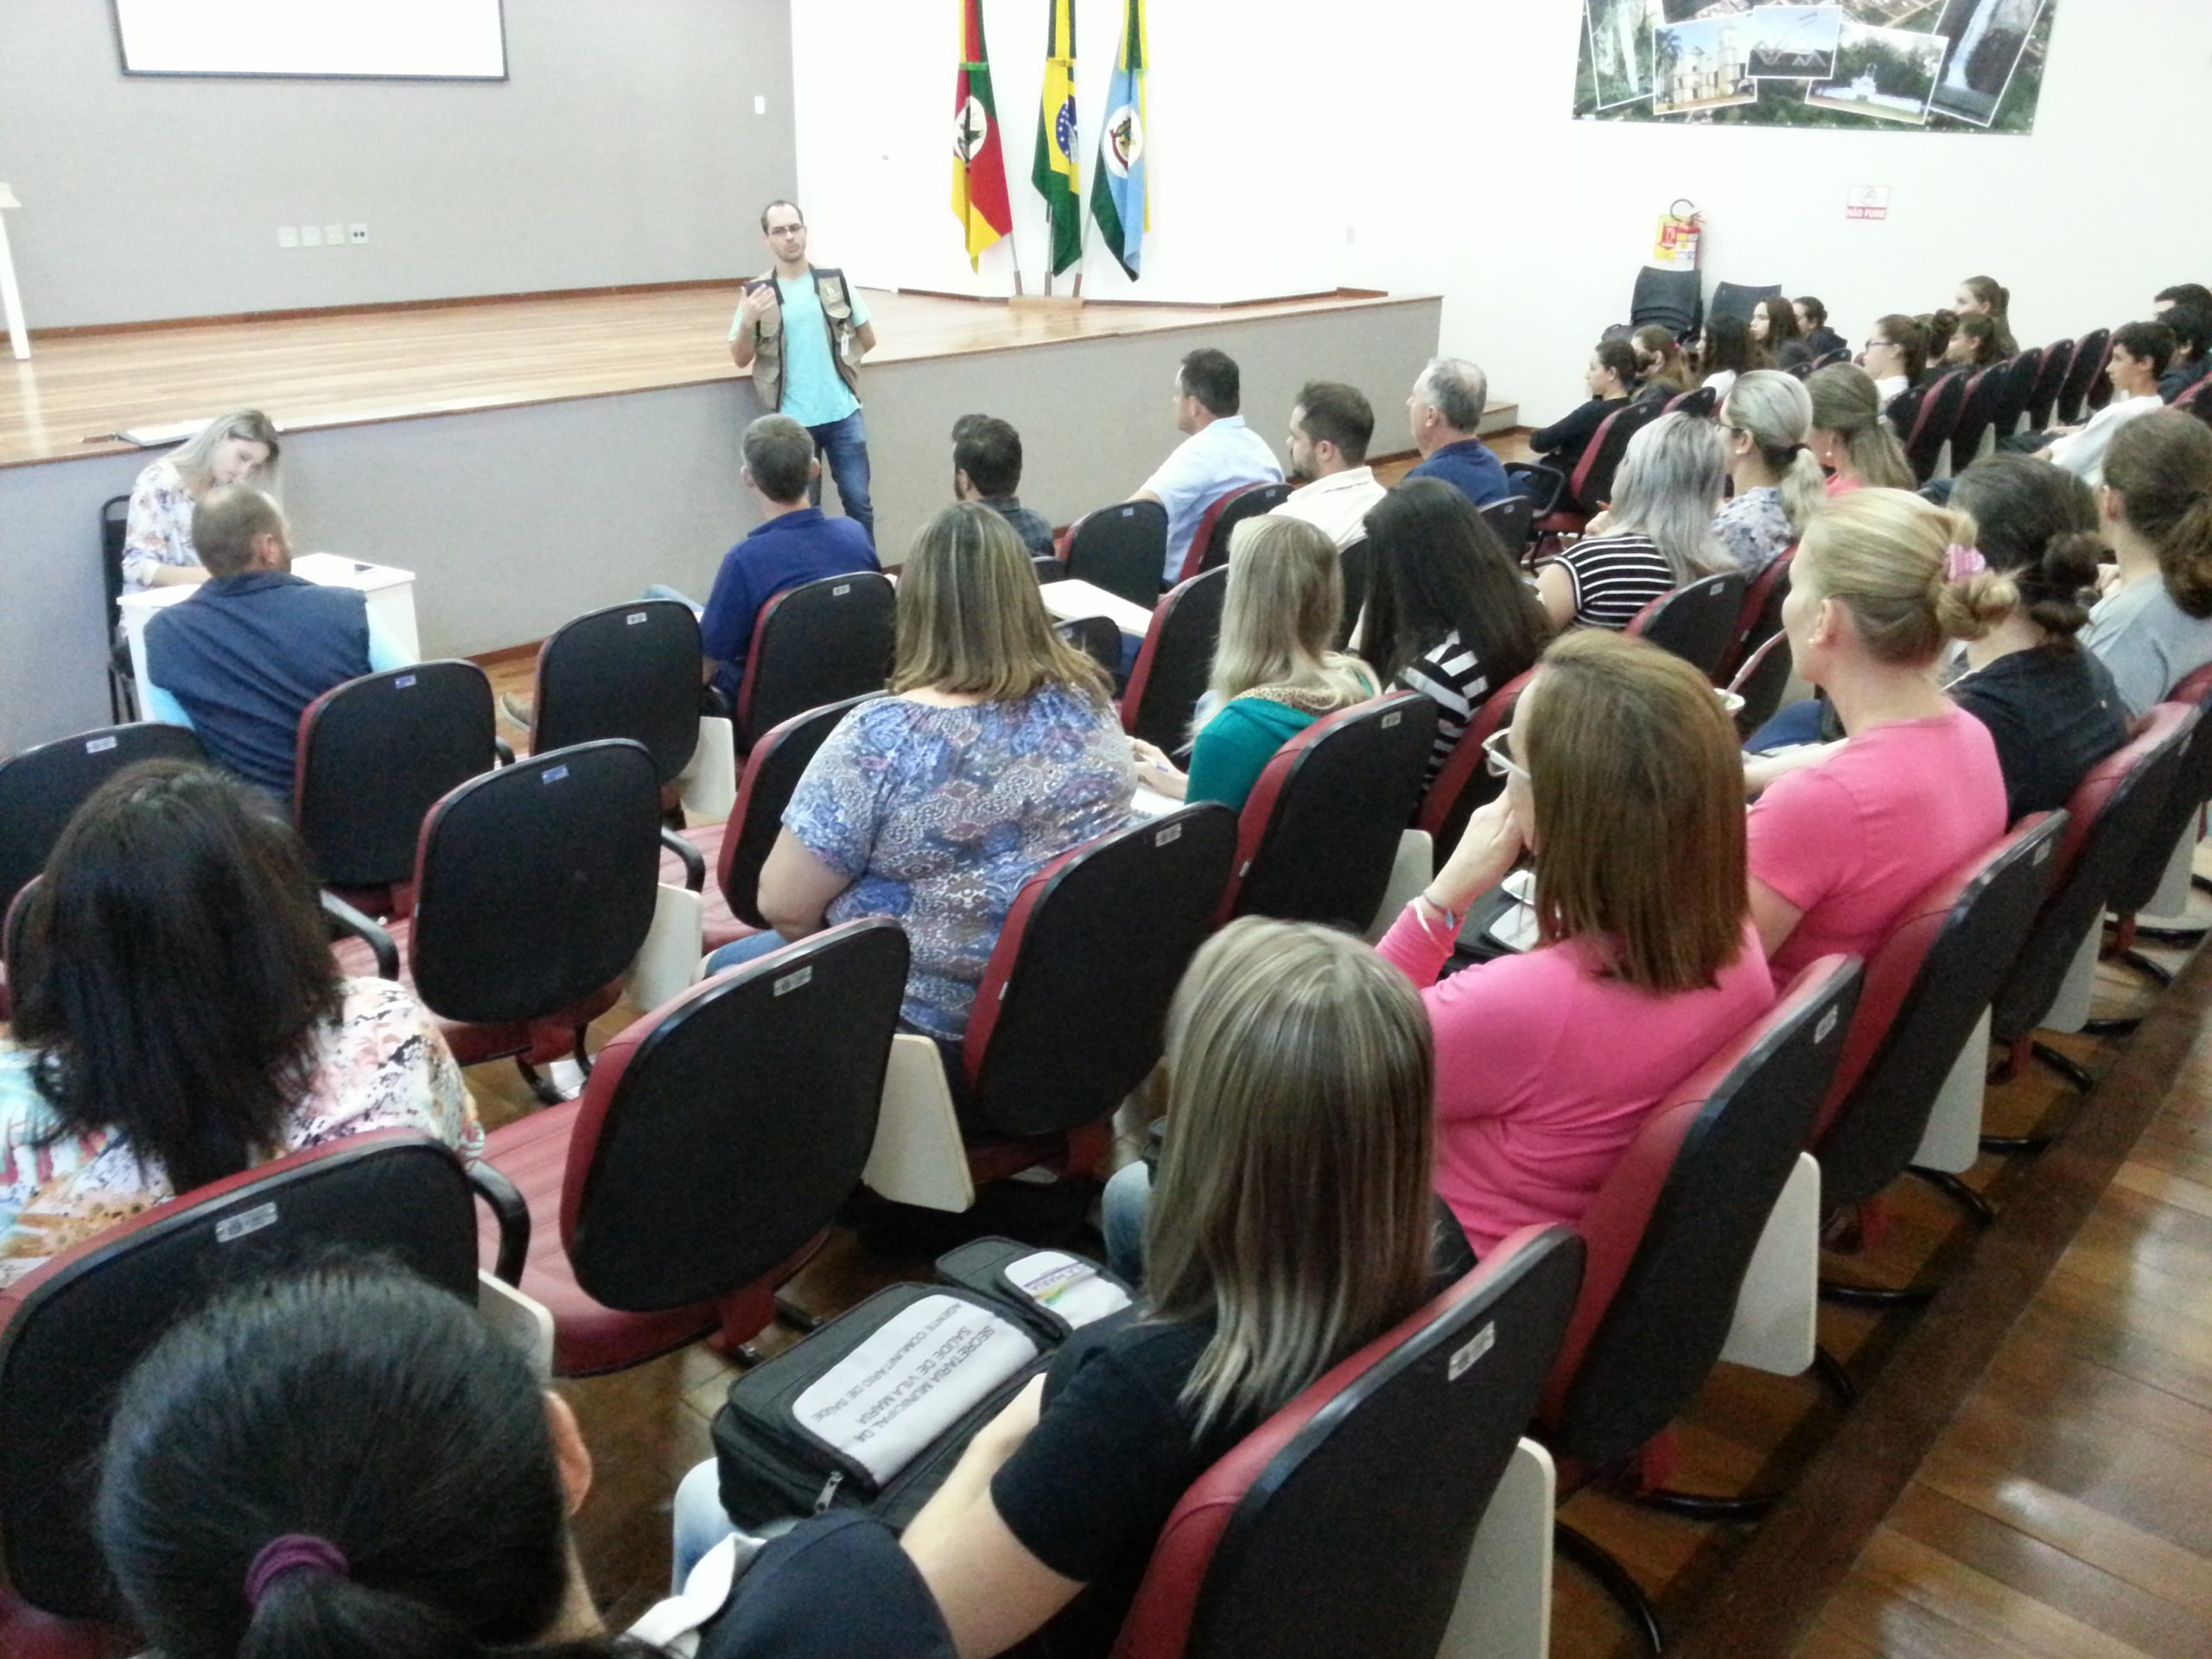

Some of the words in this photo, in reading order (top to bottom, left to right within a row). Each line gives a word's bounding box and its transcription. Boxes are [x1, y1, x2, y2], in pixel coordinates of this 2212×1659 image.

[923, 1303, 961, 1333] AGENTE
[930, 1325, 995, 1382] SECRETARIA
[915, 1358, 936, 1376] DE
[845, 1384, 863, 1399] DE
[891, 1375, 920, 1395] VILA
[854, 1394, 895, 1425] MARIA
[870, 1380, 933, 1429] MUNICIPAL
[853, 1427, 875, 1441] DA
